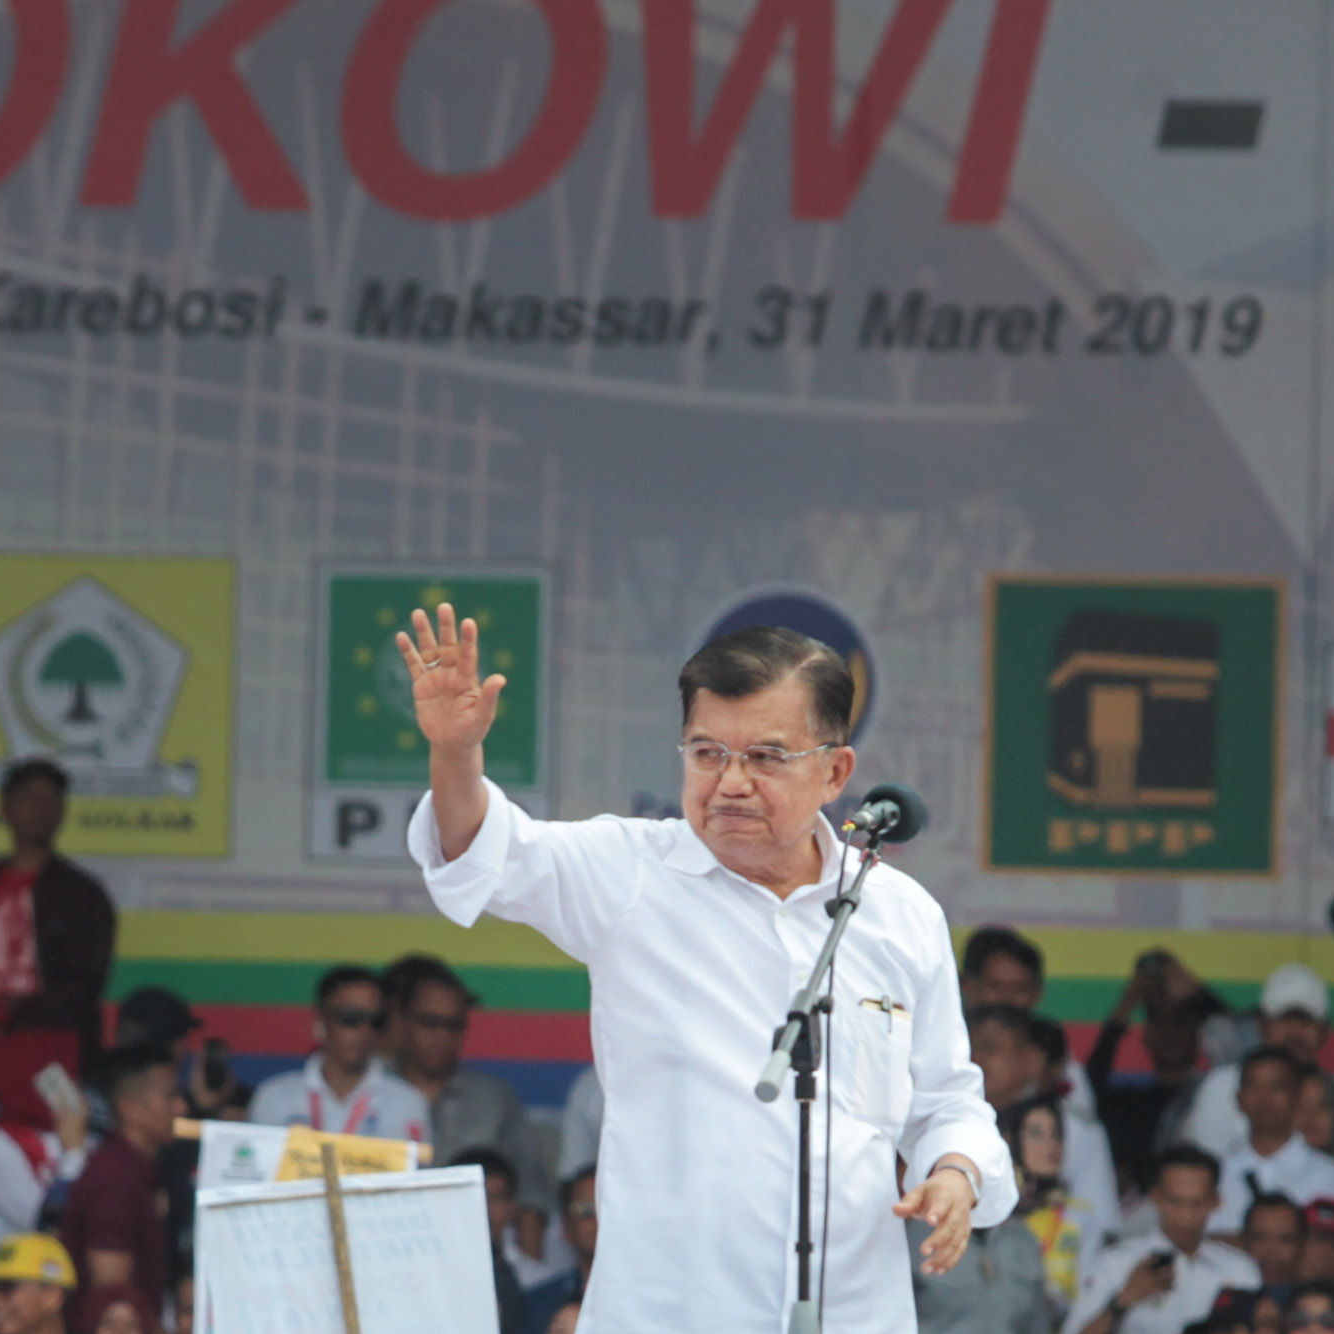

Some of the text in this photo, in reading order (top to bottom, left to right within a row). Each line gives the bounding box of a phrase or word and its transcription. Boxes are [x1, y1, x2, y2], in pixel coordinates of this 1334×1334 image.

[352, 278, 721, 355] Makassar,
[747, 285, 831, 350] 31
[859, 287, 1064, 356] Maret
[1081, 294, 1266, 358] 2019
[1046, 819, 1217, 856] PPP
